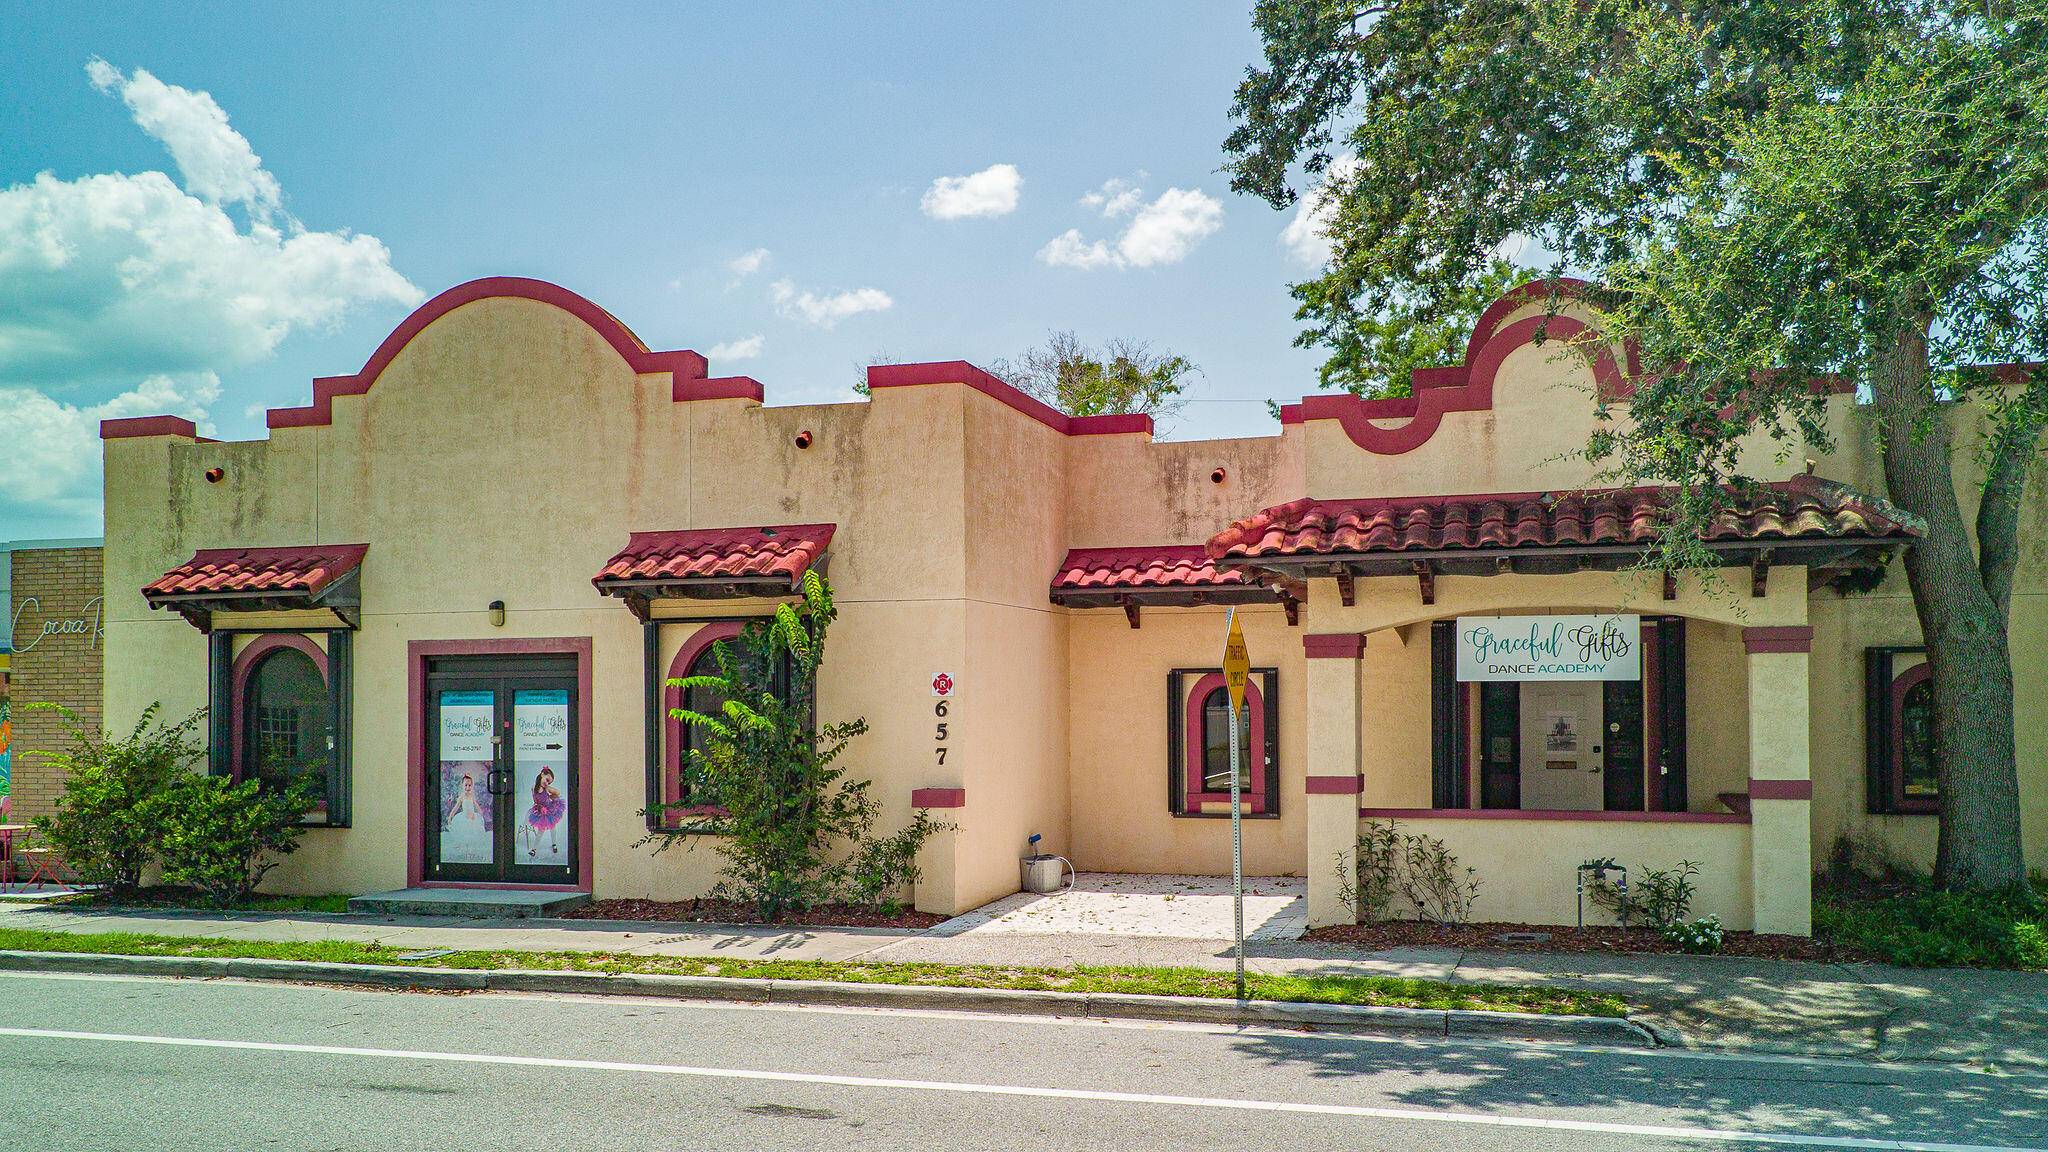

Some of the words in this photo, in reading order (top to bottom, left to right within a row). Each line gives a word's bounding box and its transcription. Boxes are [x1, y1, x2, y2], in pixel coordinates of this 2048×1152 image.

[10, 597, 88, 653] Cocoa
[1464, 622, 1564, 663] Graceful
[1568, 620, 1632, 663] Gifts
[1228, 645, 1244, 660] TRAFFIC
[1488, 664, 1535, 674] DANCE
[1538, 663, 1606, 674] ACADEMY
[1230, 671, 1244, 687] CIRCLE
[473, 715, 492, 733] Gifts
[547, 715, 567, 733] Gifts
